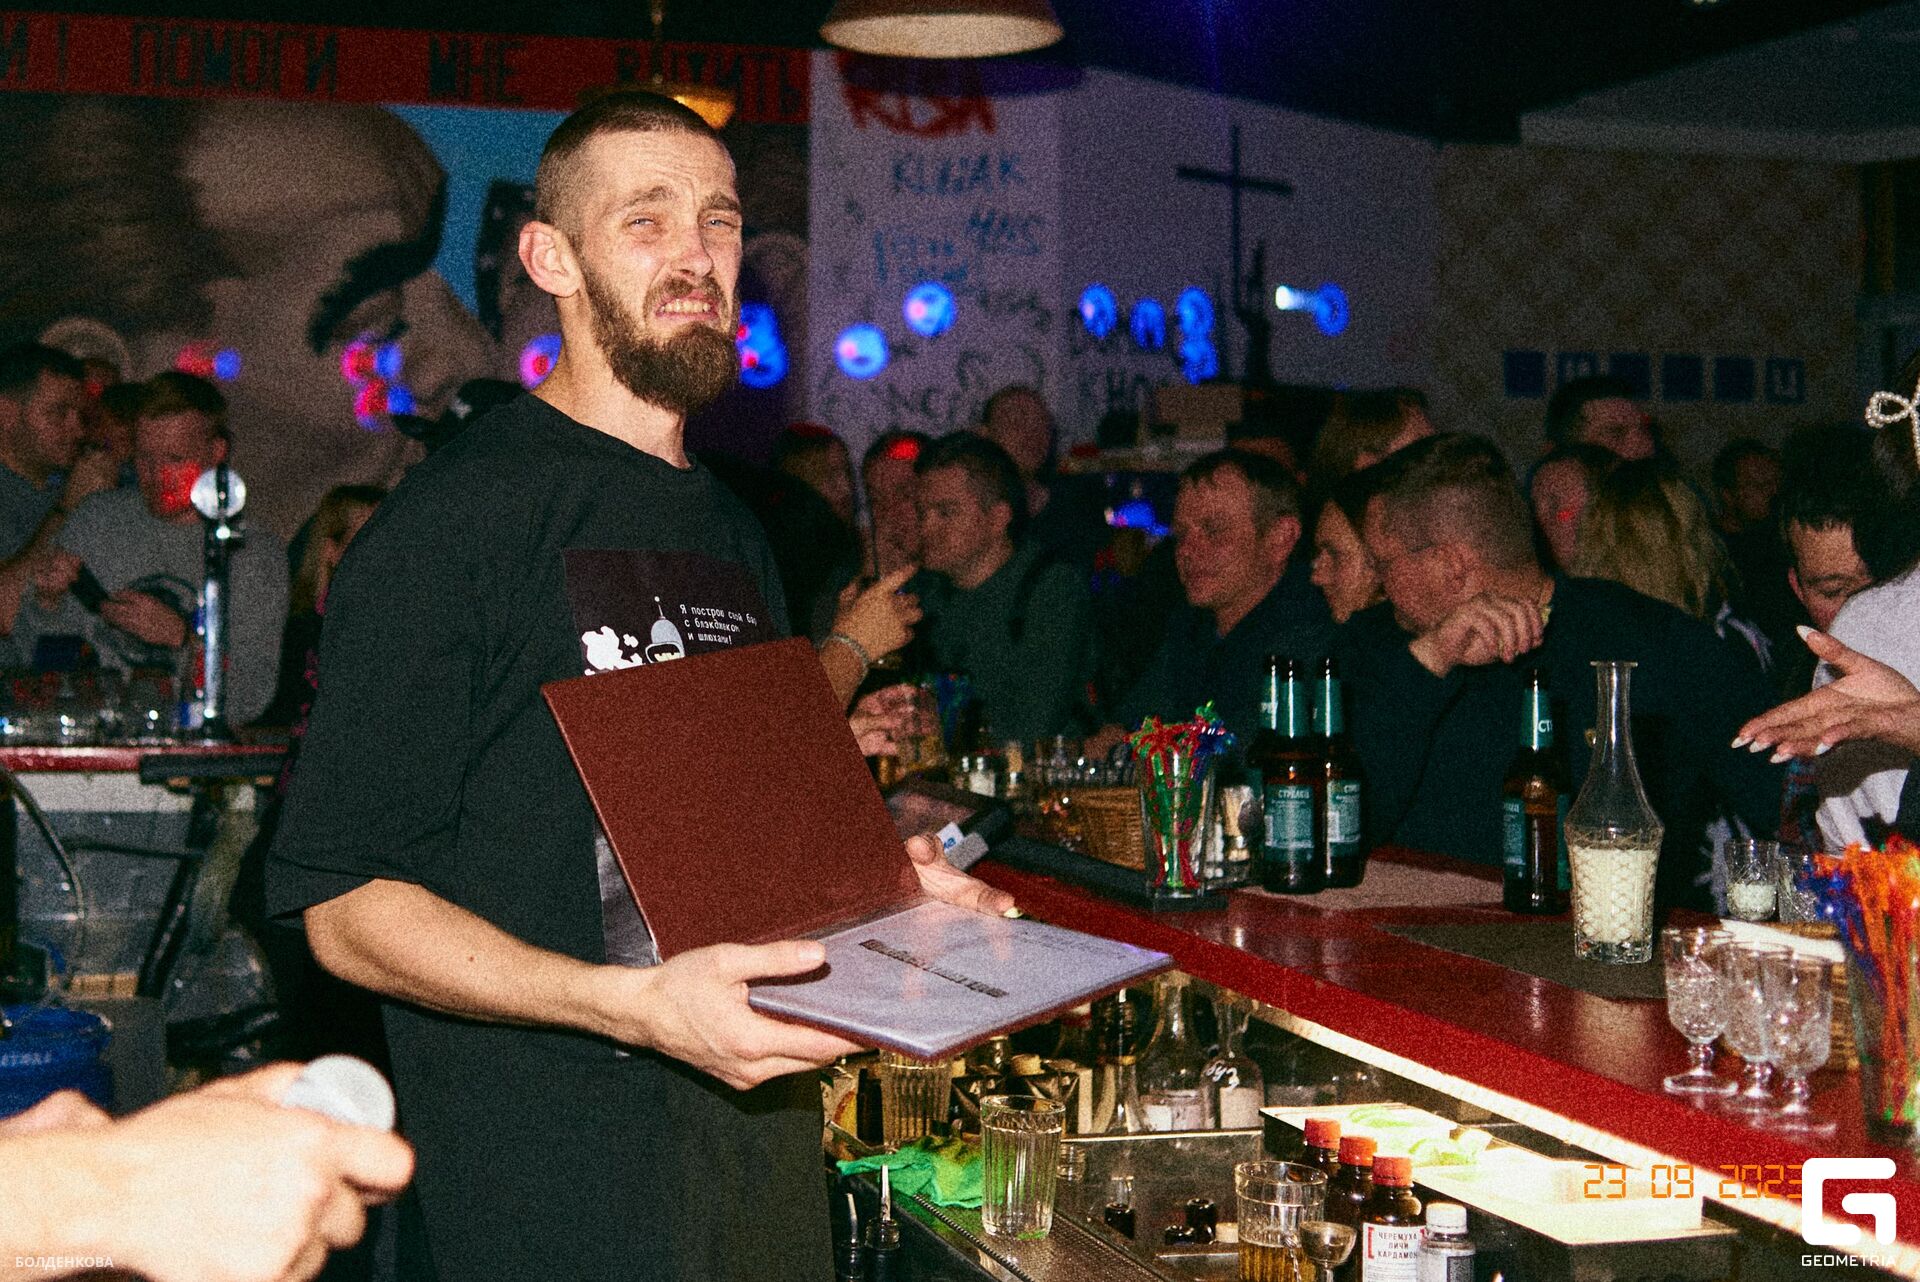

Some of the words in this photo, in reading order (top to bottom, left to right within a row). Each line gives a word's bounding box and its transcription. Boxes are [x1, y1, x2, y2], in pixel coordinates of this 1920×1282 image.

[131, 23, 338, 95] ПОМОГИ
[428, 36, 525, 103] МНЕ
[679, 603, 687, 614] Я
[684, 619, 690, 627] с
[687, 632, 694, 641] и
[1378, 1231, 1418, 1240] ЧЕРЕМУХА
